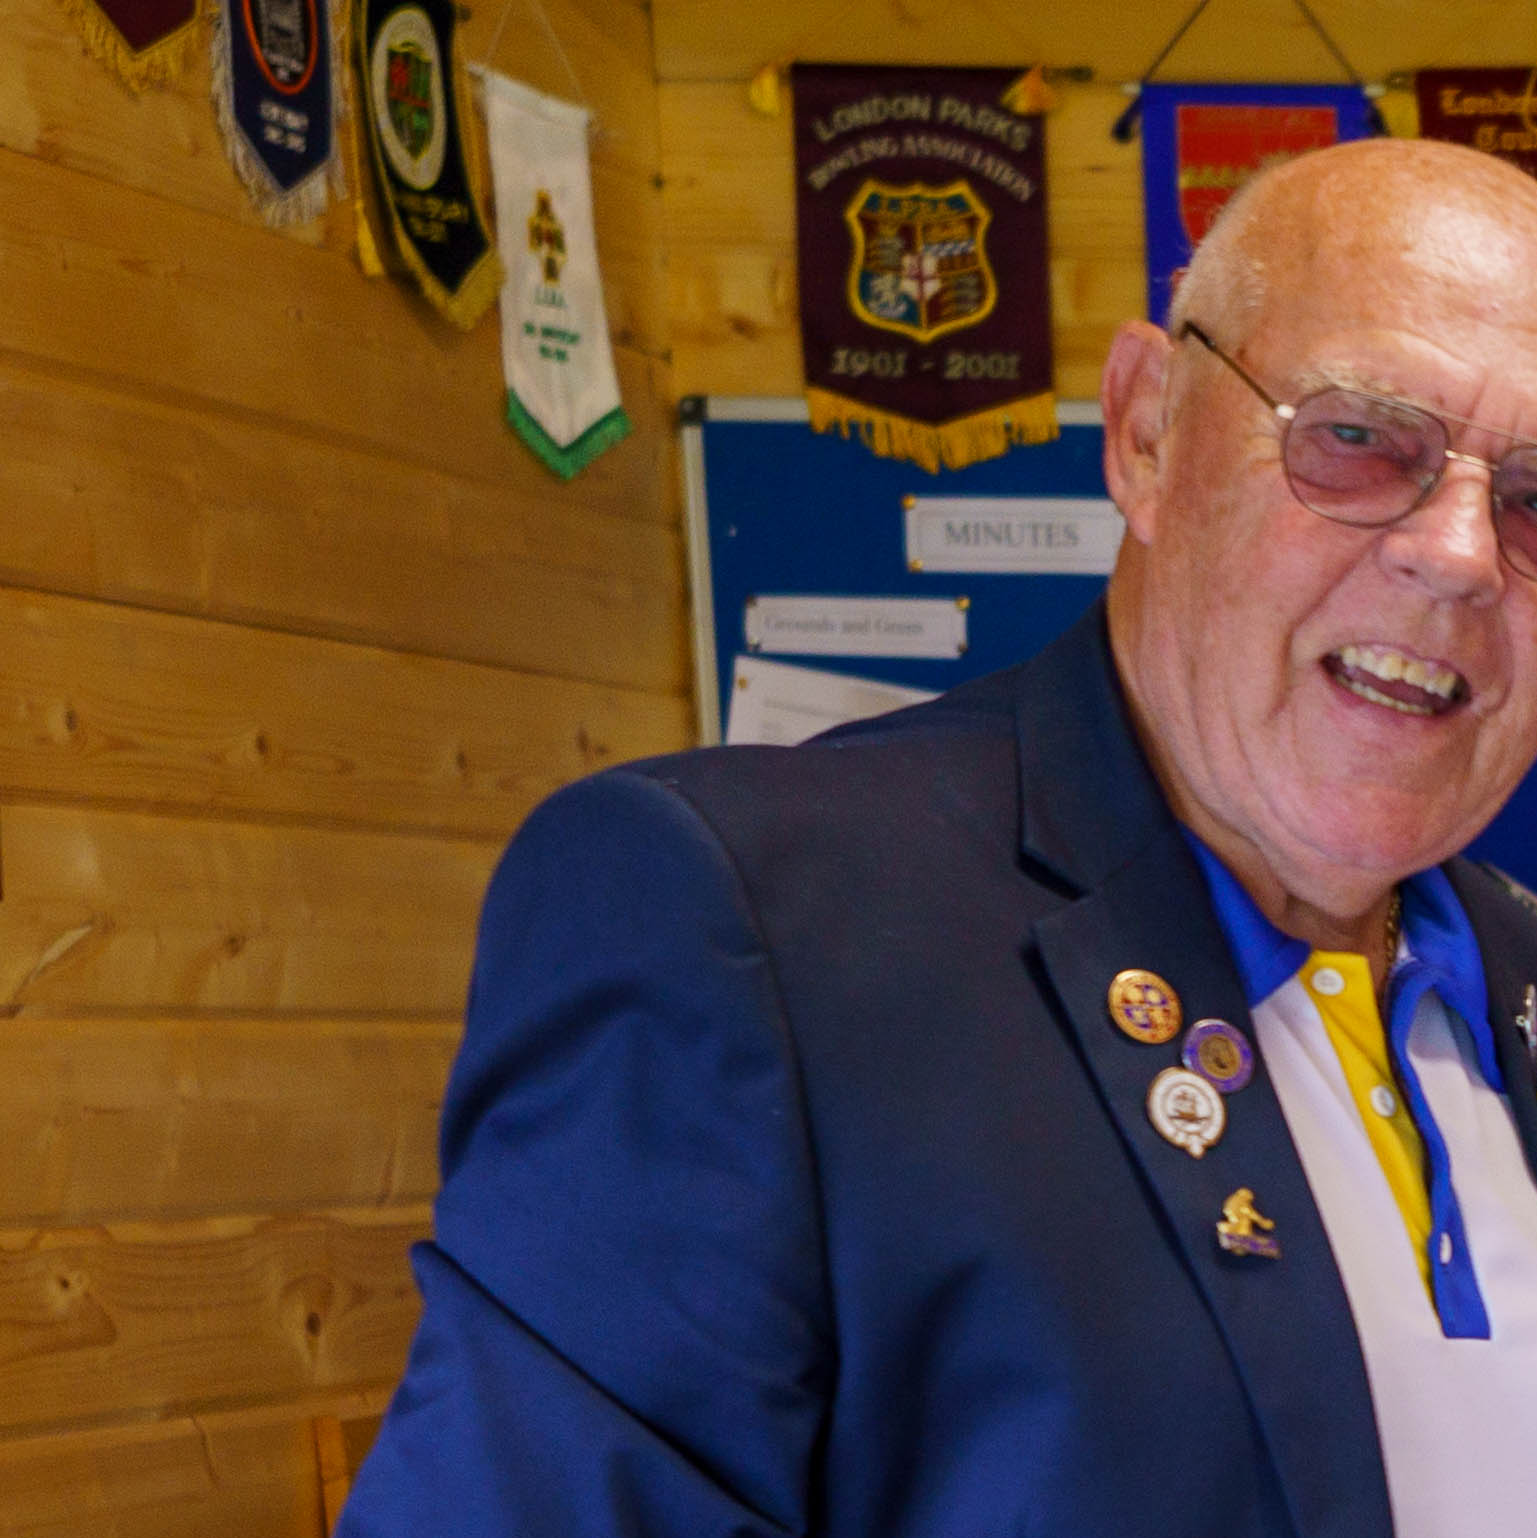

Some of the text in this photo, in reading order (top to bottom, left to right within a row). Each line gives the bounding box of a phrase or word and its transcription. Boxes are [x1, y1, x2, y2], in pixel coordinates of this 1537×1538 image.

[811, 94, 1031, 152] LONDON PARKS
[808, 135, 898, 191] BOWLING
[944, 353, 1021, 380] 2001
[945, 521, 1080, 548] MINUTES
[764, 614, 834, 633] Grounds
[842, 616, 870, 634] and
